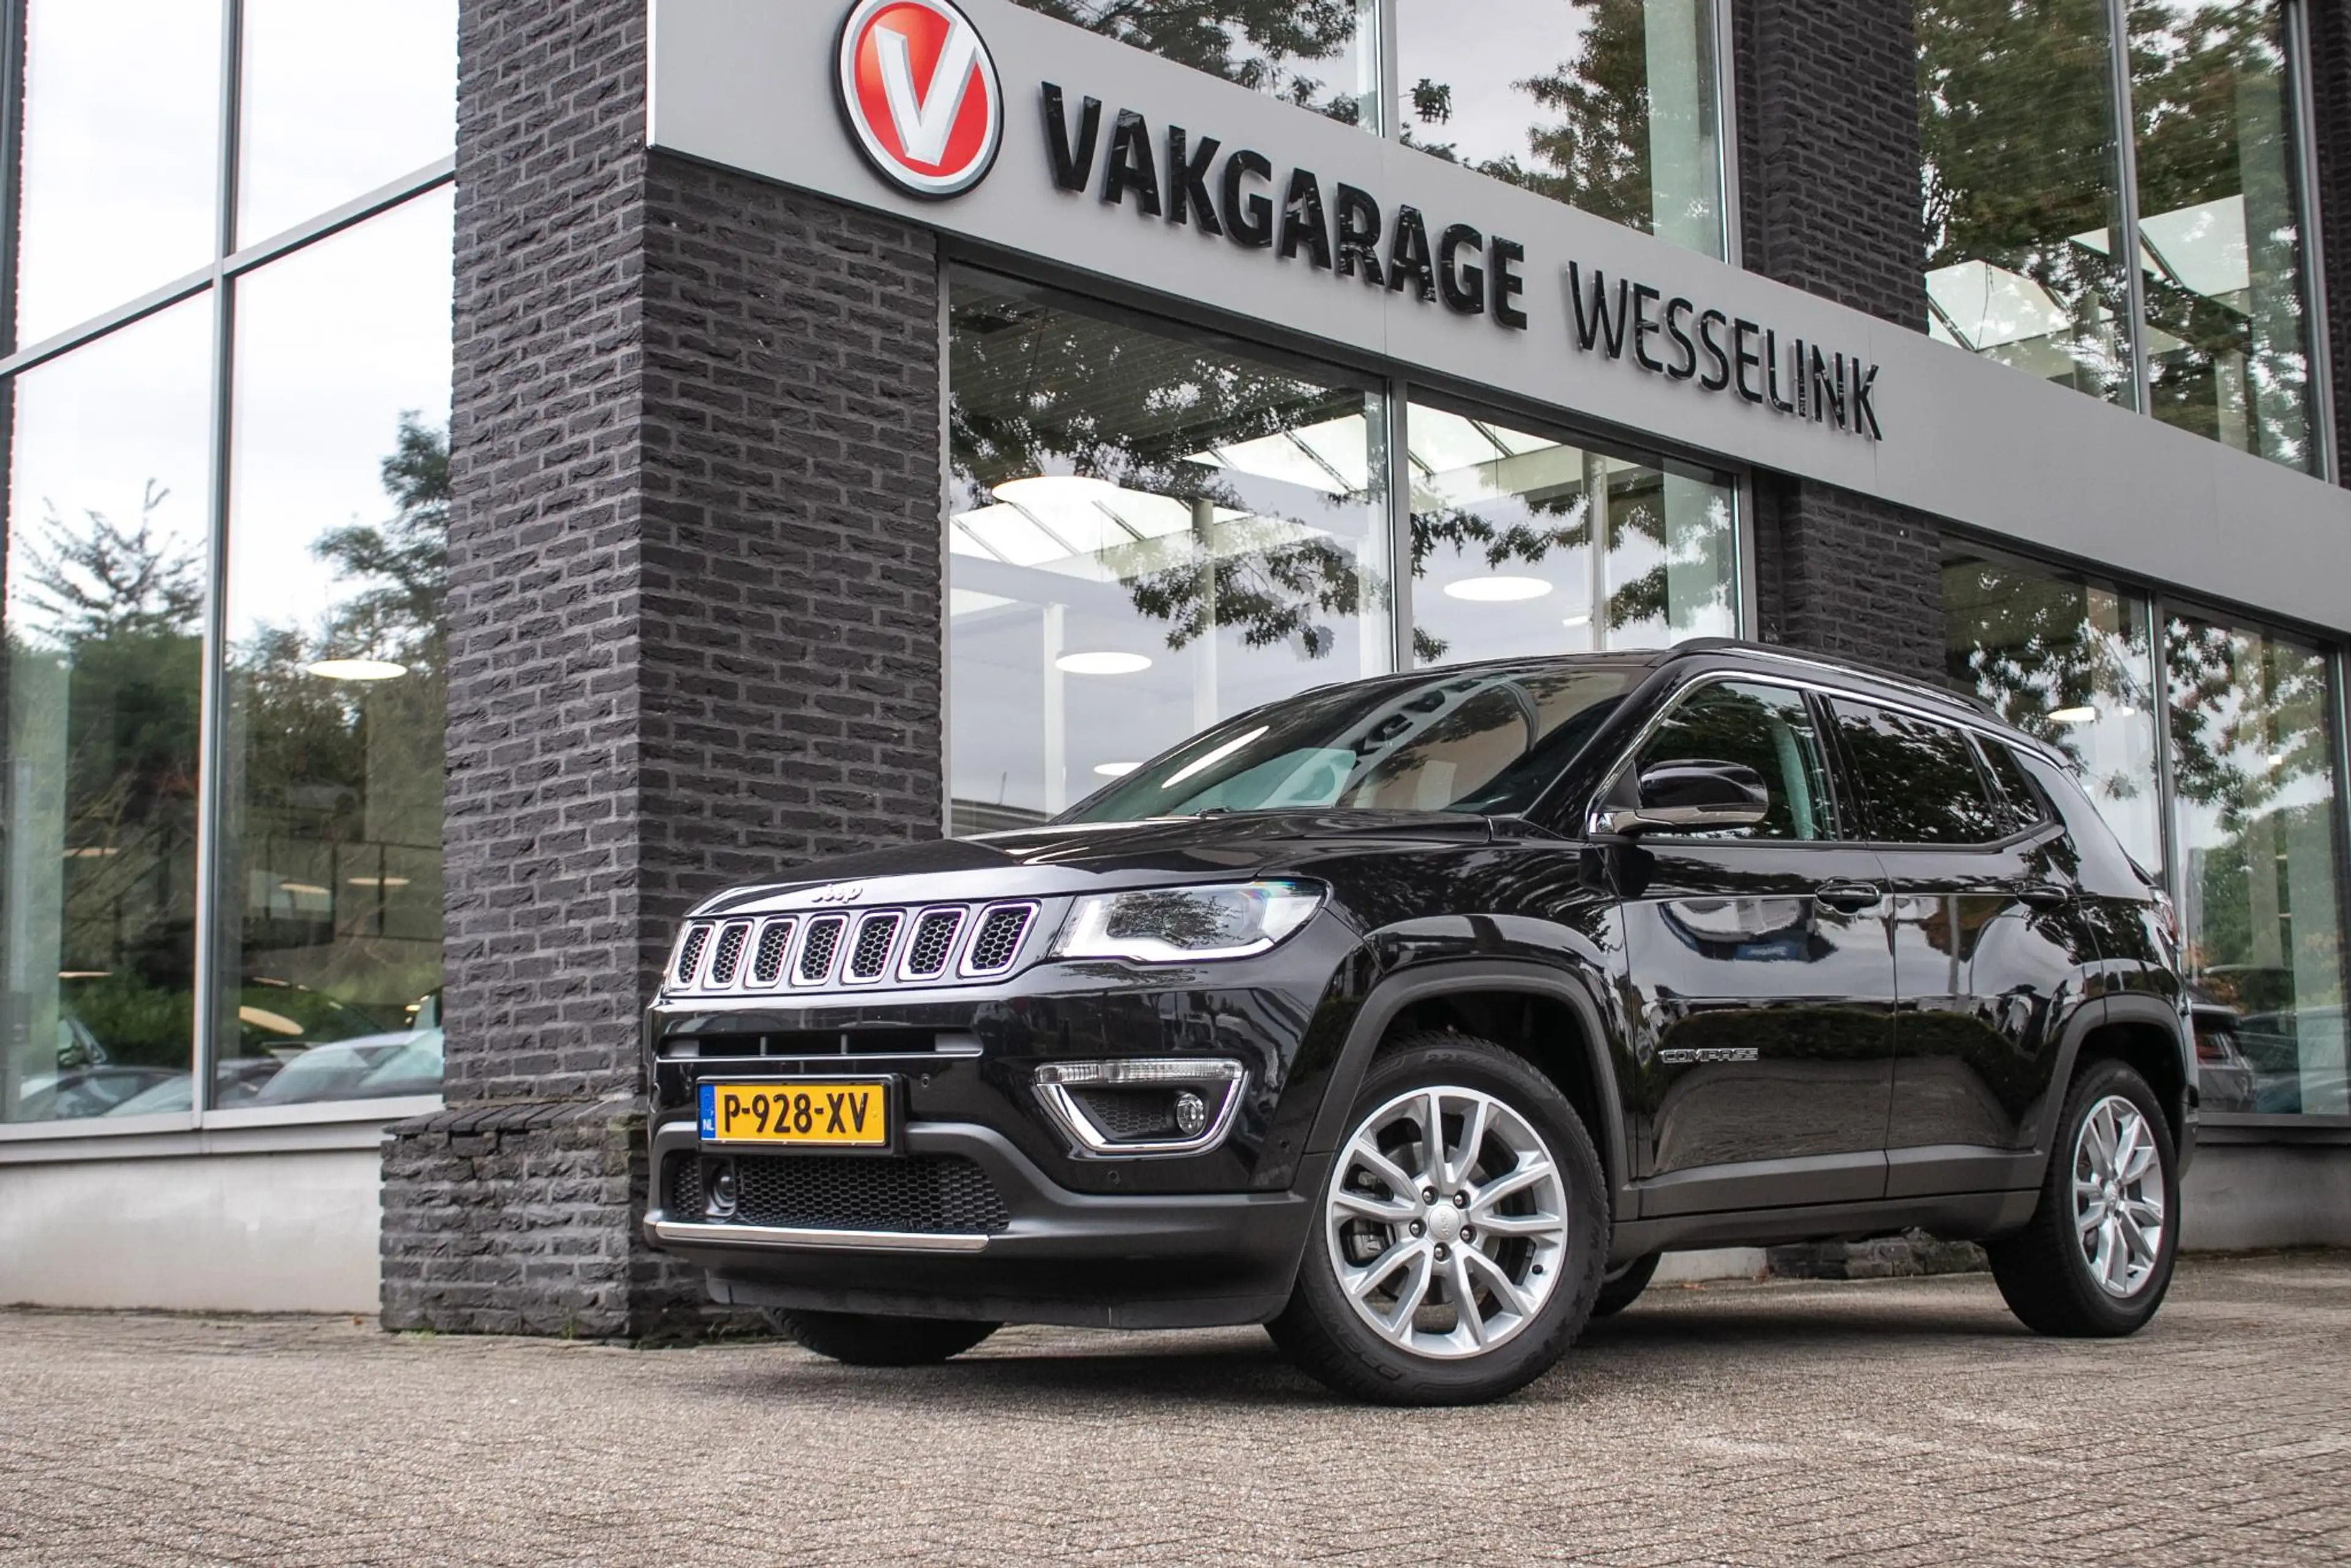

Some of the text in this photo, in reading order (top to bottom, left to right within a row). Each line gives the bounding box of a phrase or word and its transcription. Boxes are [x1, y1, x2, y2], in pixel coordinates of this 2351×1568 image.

[1041, 80, 1883, 441] VAKGARAGE WESSELINK
[702, 1118, 714, 1131] NL
[723, 1092, 869, 1134] P-928-XV
